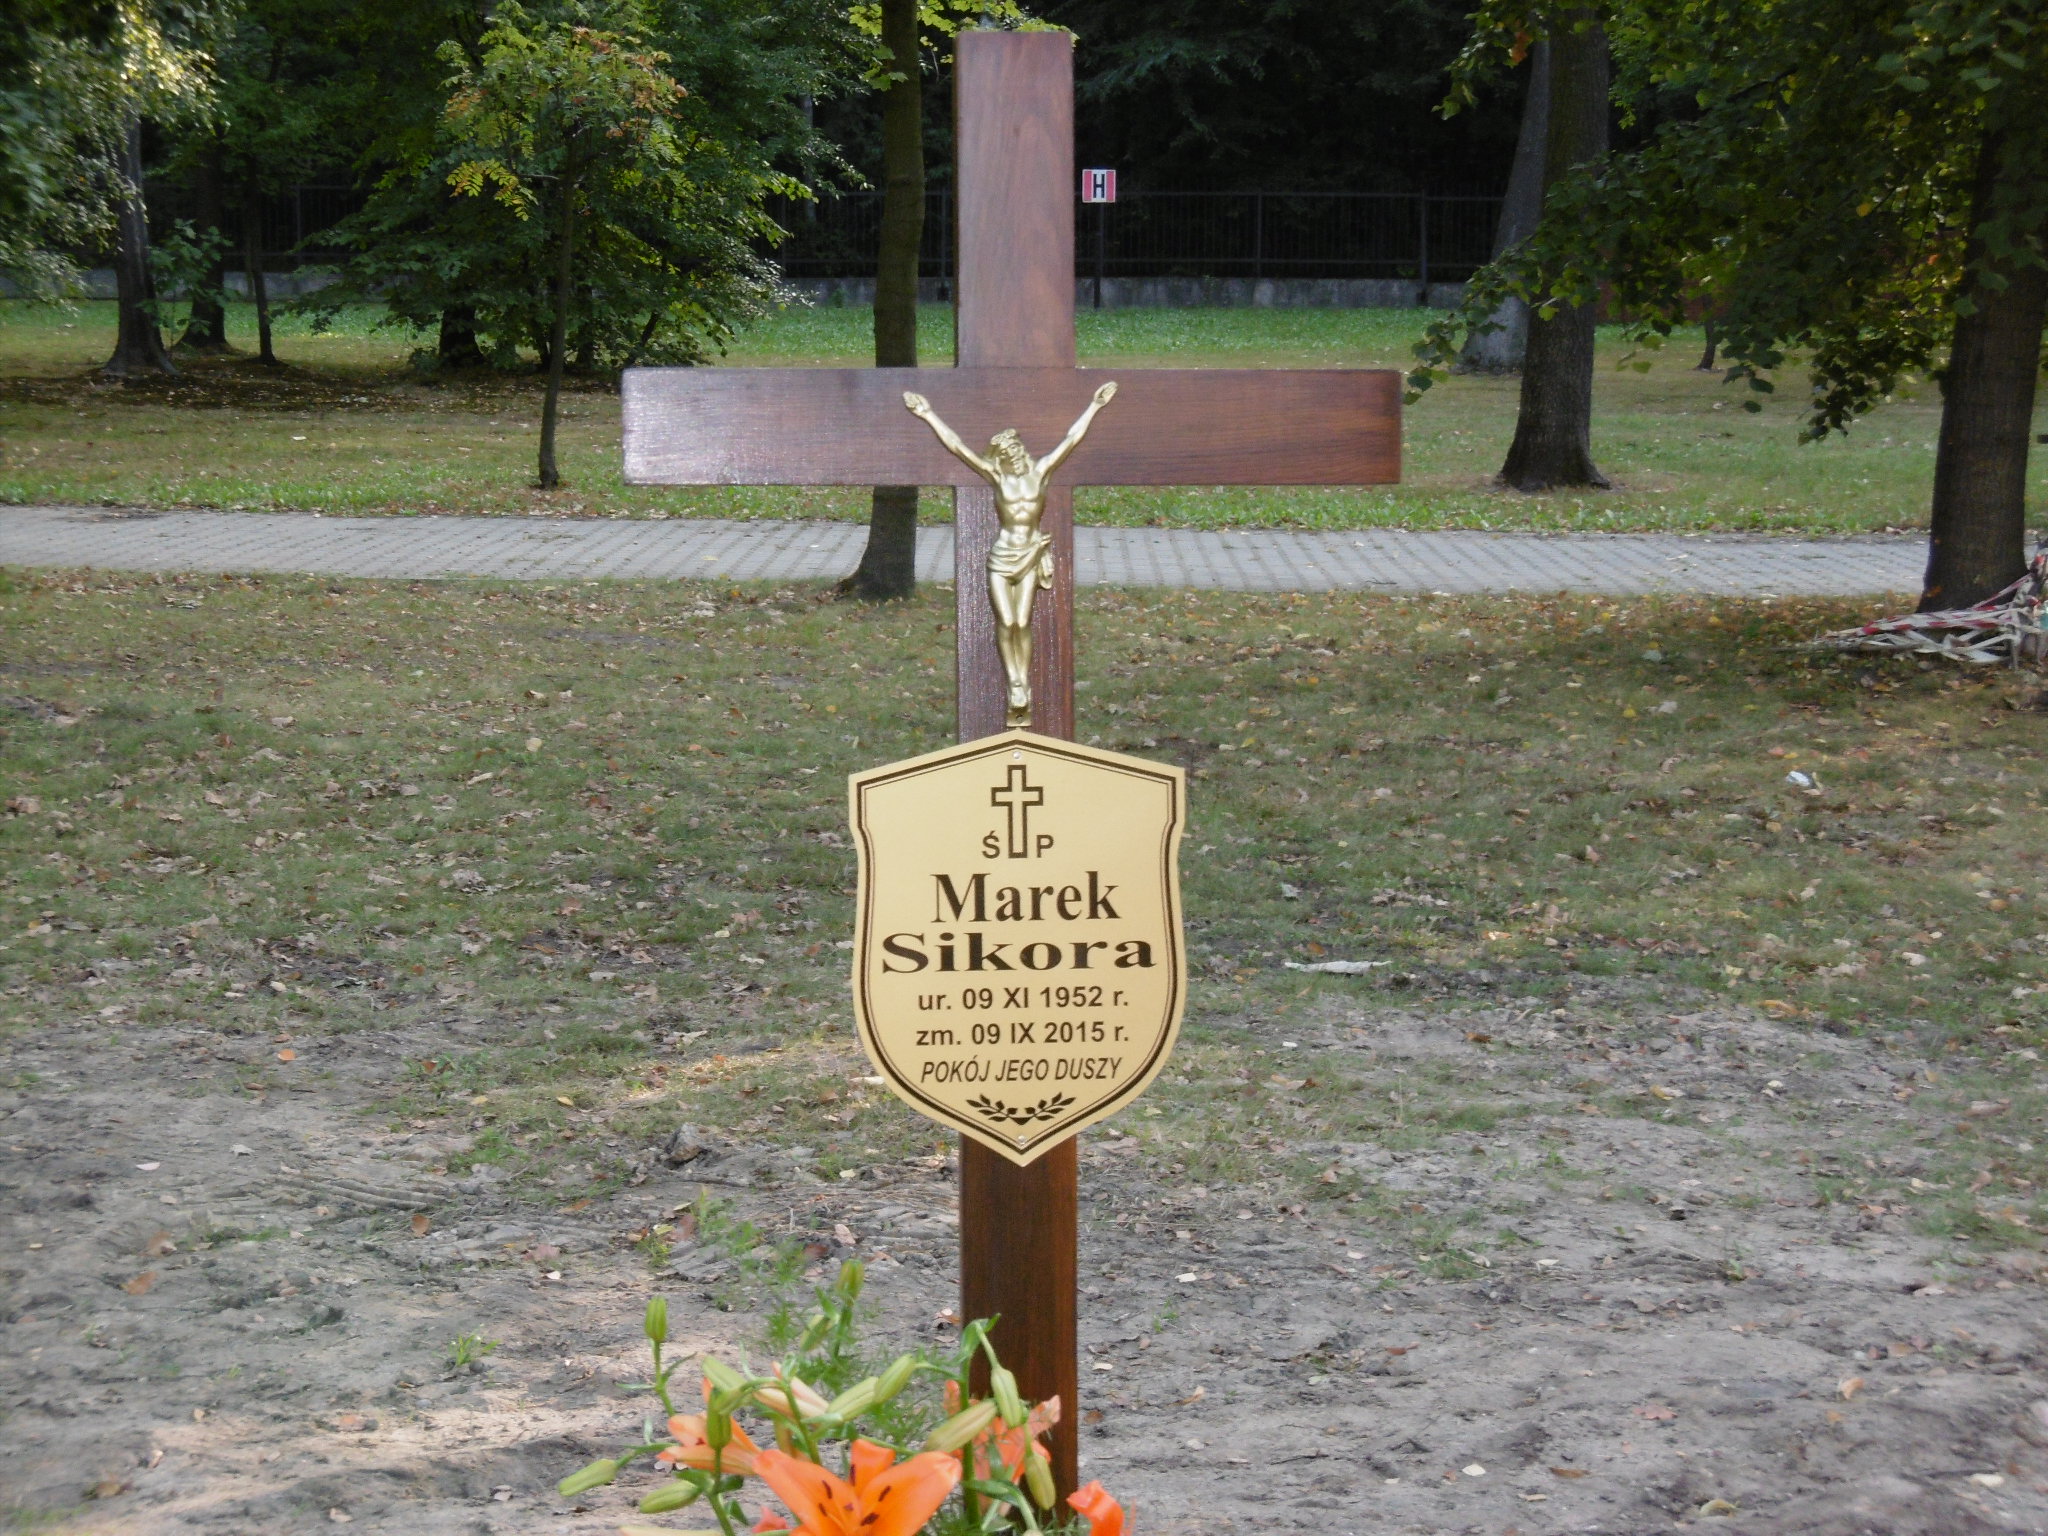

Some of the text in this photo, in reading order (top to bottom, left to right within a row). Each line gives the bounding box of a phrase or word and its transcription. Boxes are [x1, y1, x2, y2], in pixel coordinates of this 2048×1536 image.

[1093, 173, 1105, 198] H
[982, 830, 1054, 859] Ś P
[931, 870, 1121, 923] Marek
[882, 932, 1157, 974] Sikora
[918, 985, 1129, 1011] ur. 09 XI 1952 r.
[916, 1020, 1129, 1047] zm. 09 IX 2015 r.
[920, 1054, 1123, 1084] POKÓJ JEGO DUSZY
